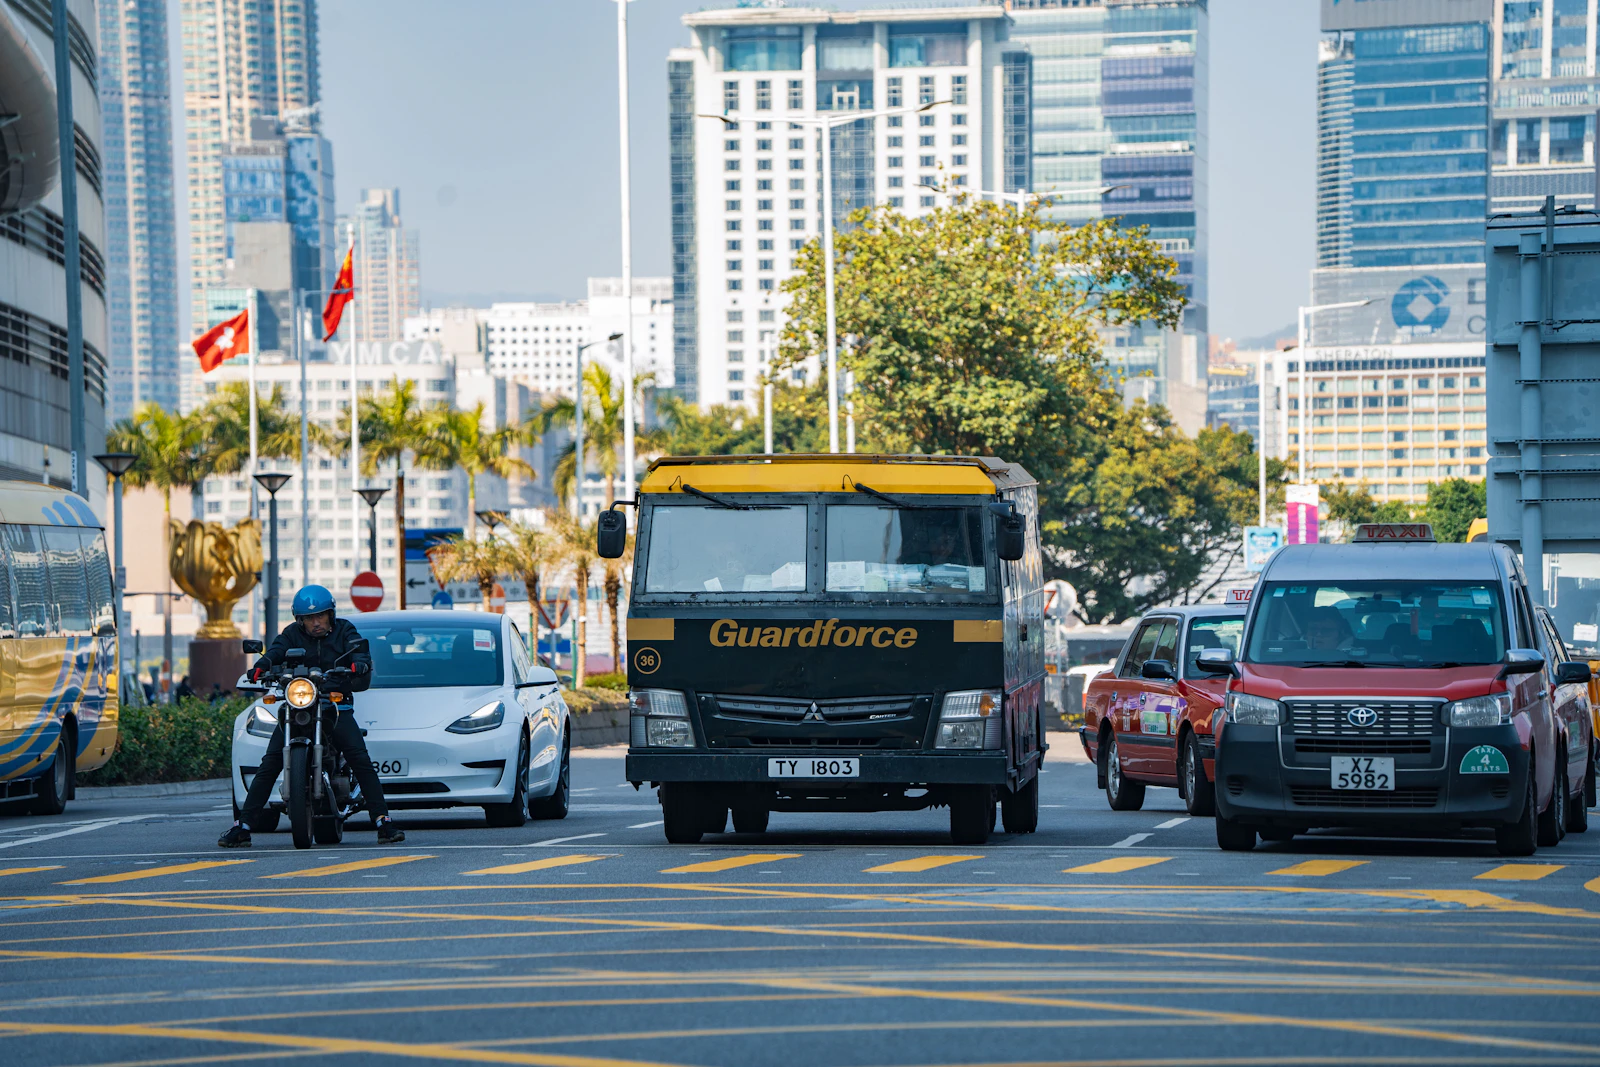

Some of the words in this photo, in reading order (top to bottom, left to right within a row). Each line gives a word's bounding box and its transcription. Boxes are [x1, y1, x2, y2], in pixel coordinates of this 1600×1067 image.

[330, 341, 438, 364] YMCA
[1315, 348, 1393, 360] SHERATON
[1363, 525, 1426, 537] TAXI
[709, 618, 918, 648] Guardforce
[640, 655, 655, 667] 36
[1475, 747, 1495, 755] TAXI
[1351, 758, 1375, 773] XZ
[1480, 754, 1490, 765] 4
[776, 761, 798, 775] TY
[812, 761, 852, 775] 1803
[1338, 774, 1389, 788] 5982
